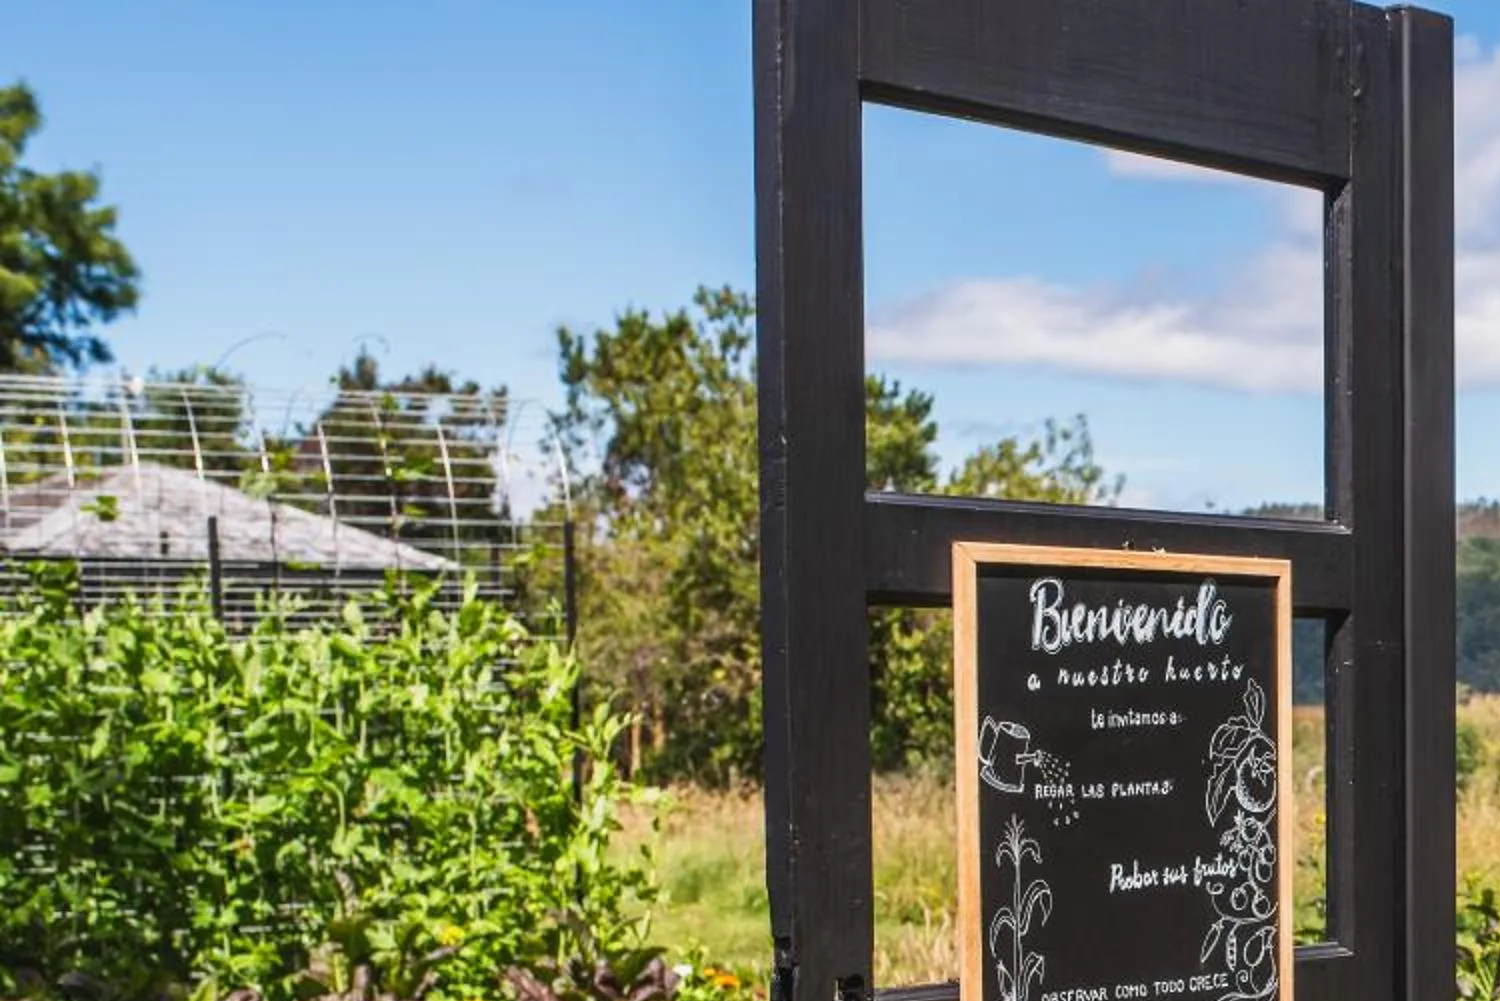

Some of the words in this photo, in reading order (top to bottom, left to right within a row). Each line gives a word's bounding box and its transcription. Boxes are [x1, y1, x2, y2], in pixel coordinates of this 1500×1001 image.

[1029, 577, 1233, 655] Bienvenido
[1027, 673, 1042, 692] a
[1057, 658, 1150, 688] nuestro
[1165, 654, 1245, 683] huerto
[1034, 783, 1075, 800] REGAR
[1081, 783, 1105, 799] LAS
[1161, 864, 1189, 886] sus
[1192, 852, 1239, 887] frutos
[1115, 984, 1148, 999] COMO
[1153, 979, 1186, 996] TODO
[1188, 972, 1230, 993] CRECE
